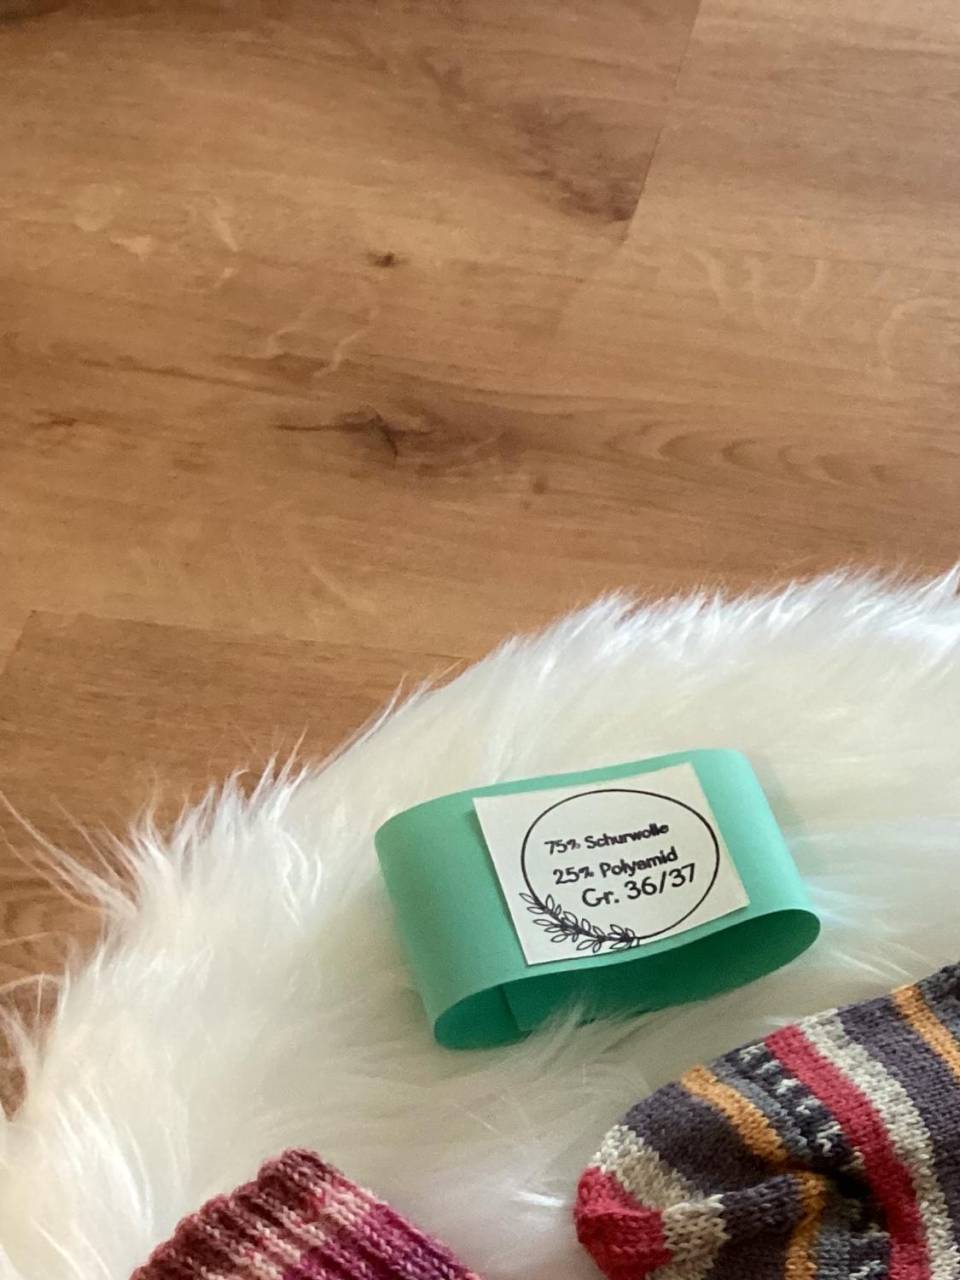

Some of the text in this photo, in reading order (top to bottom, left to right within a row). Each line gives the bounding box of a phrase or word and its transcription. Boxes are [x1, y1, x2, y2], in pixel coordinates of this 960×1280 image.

[543, 822, 670, 855] 75% Schurwolle
[553, 845, 679, 886] 25% Polyamid
[581, 862, 696, 908] Gr. 36/37
